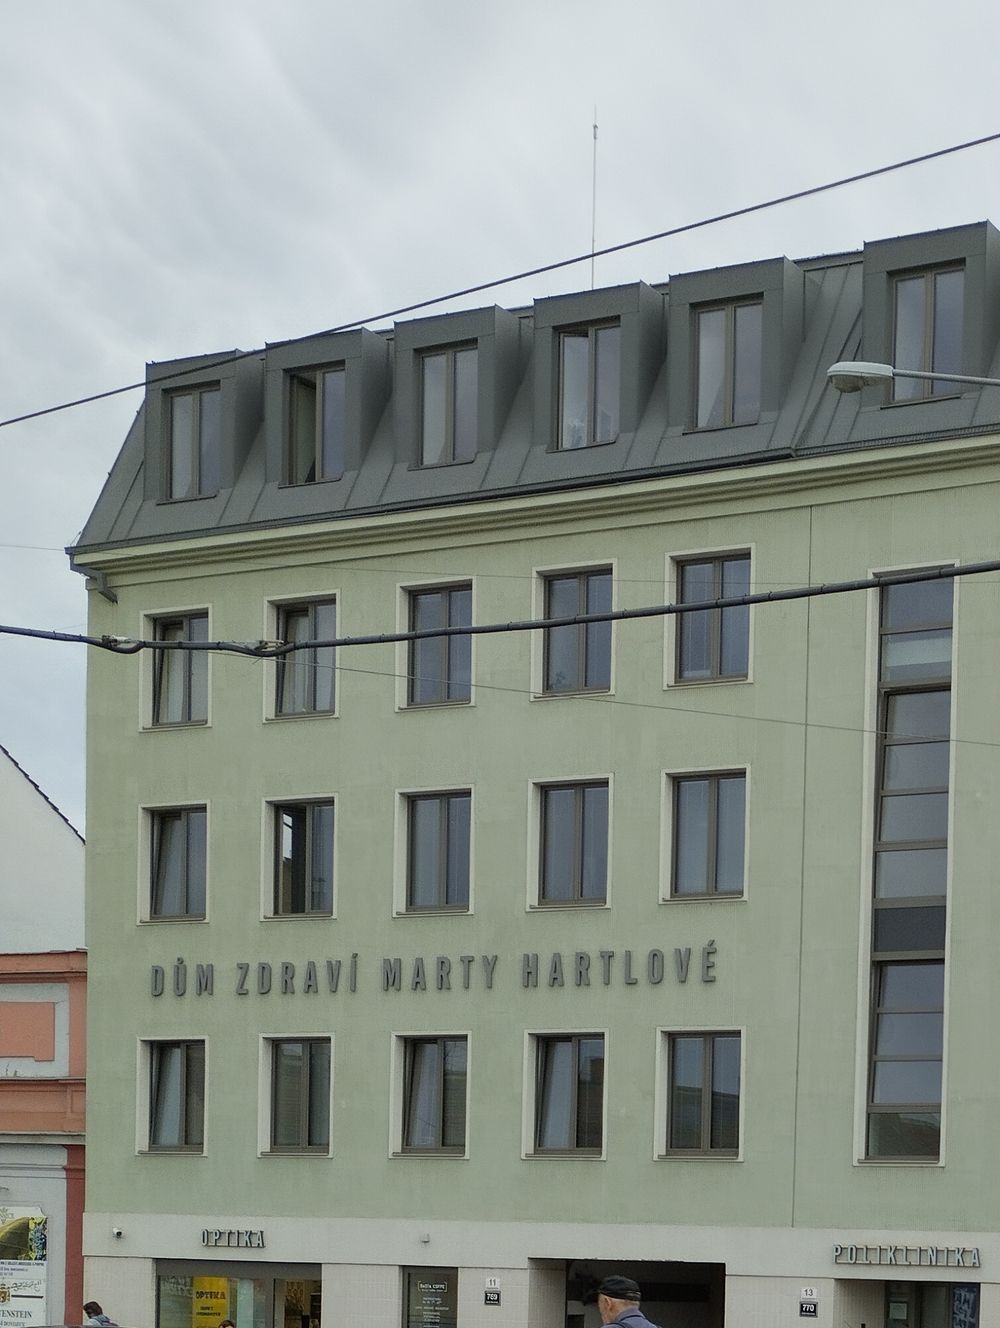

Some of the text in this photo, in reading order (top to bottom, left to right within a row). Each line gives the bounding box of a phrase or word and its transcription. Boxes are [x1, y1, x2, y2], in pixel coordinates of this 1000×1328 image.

[152, 940, 717, 996] DŮM ZDRAVÍ MARTY HARTLOVÉ
[202, 1229, 265, 1248] OPTIKA
[833, 1245, 981, 1267] POLIKLINIKA
[195, 1291, 226, 1300] OPTIKA
[804, 1288, 813, 1296] 13
[802, 1304, 815, 1312] 770
